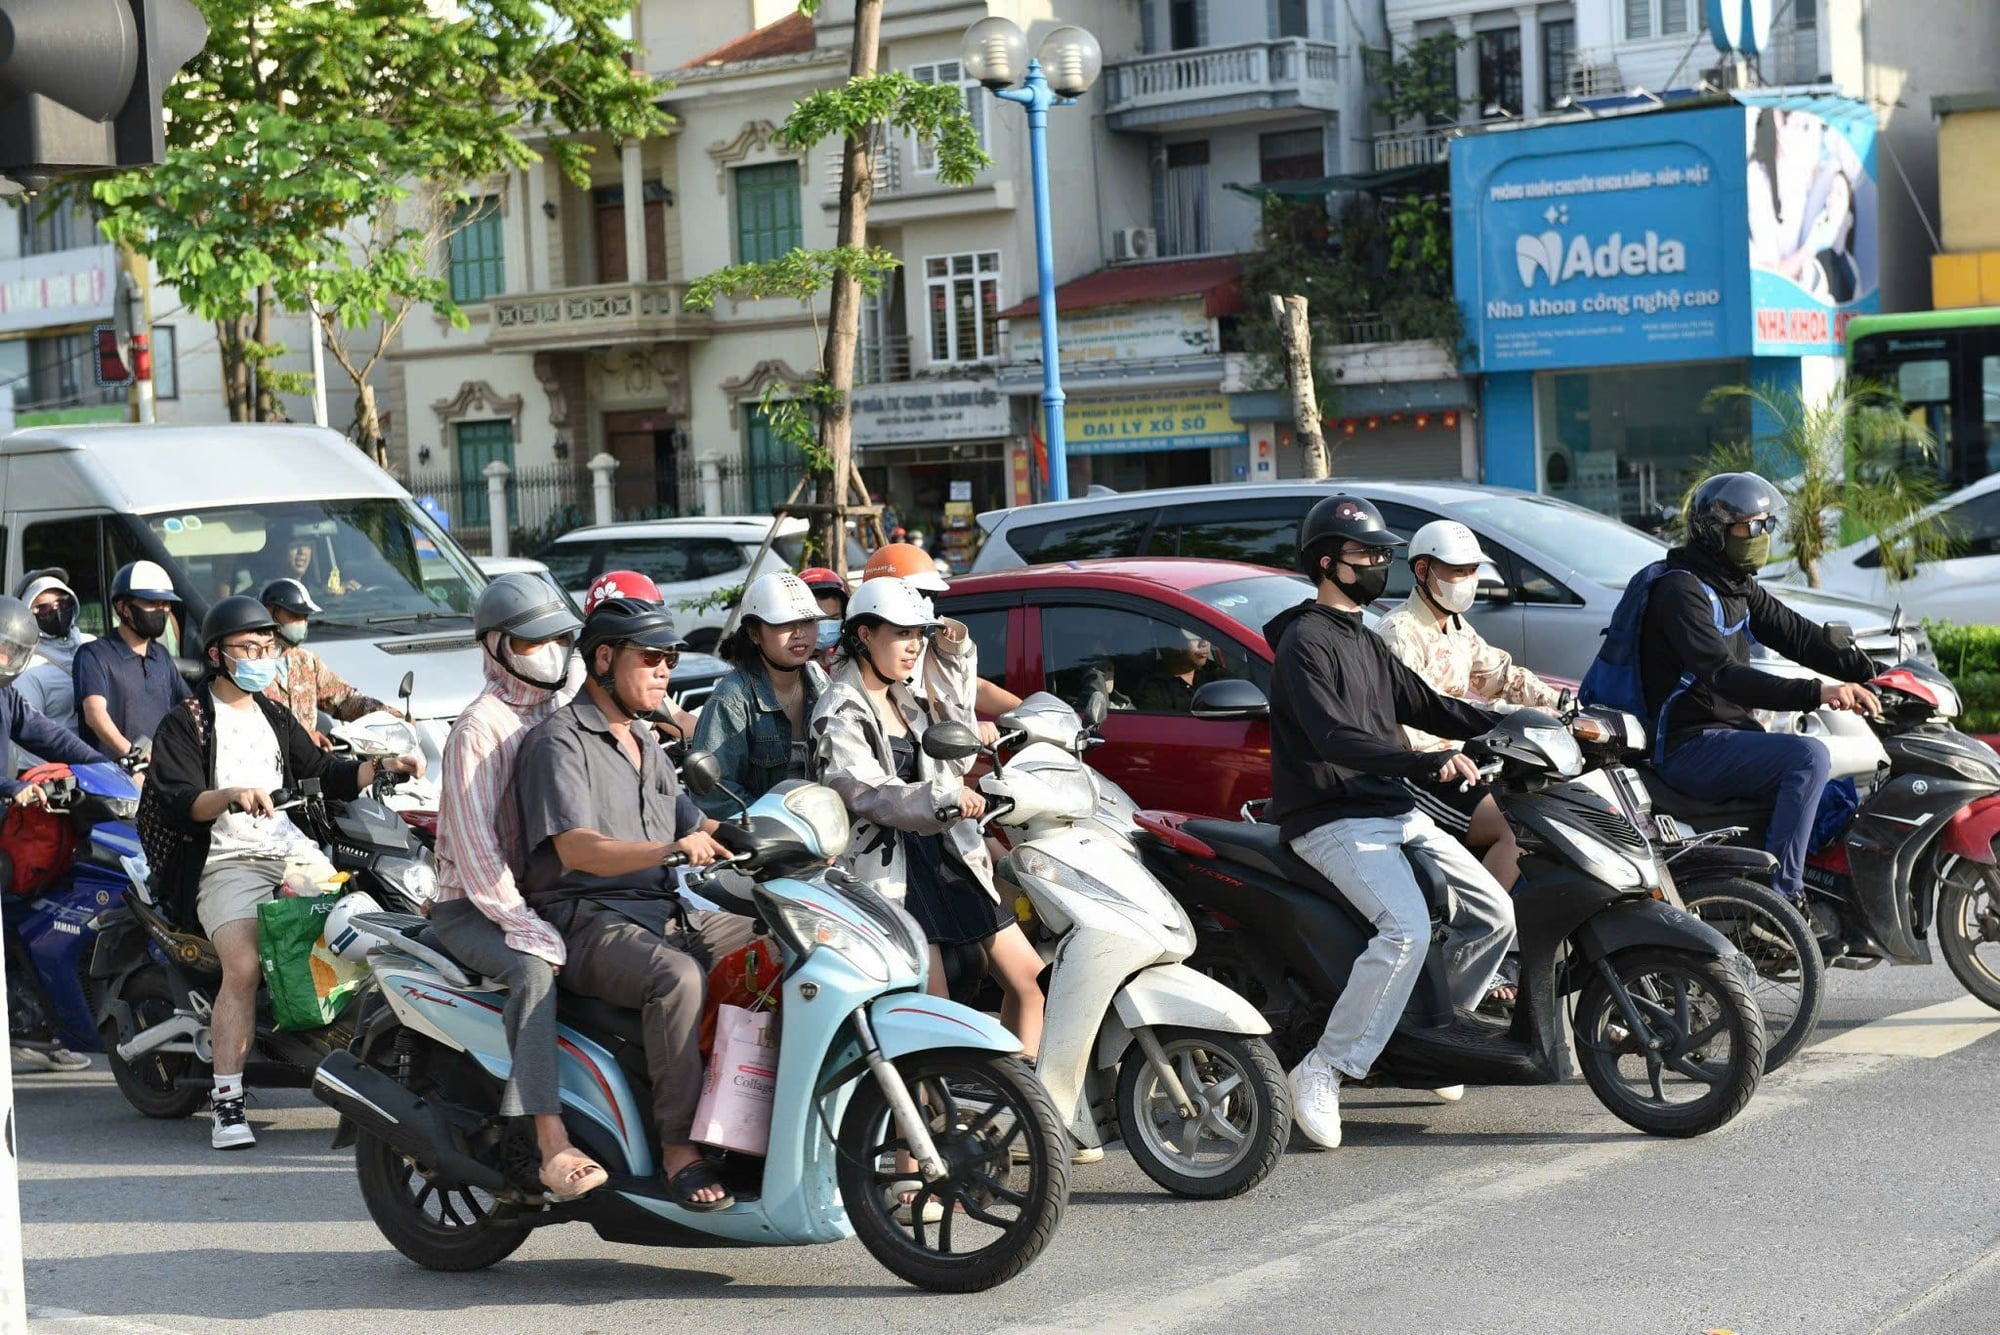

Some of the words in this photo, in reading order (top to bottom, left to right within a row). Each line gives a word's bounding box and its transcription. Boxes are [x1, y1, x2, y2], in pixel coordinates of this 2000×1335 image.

[1561, 230, 1686, 281] Adela
[1487, 300, 1523, 319] Nha
[1529, 298, 1576, 317] khoa
[1582, 292, 1630, 316] công
[1633, 288, 1680, 313] nghệ
[1684, 289, 1720, 307] cao
[1757, 310, 1786, 341] NHA
[1790, 310, 1828, 342] KHOA
[338, 843, 369, 858] VINFAST
[53, 920, 81, 936] YAMAHA
